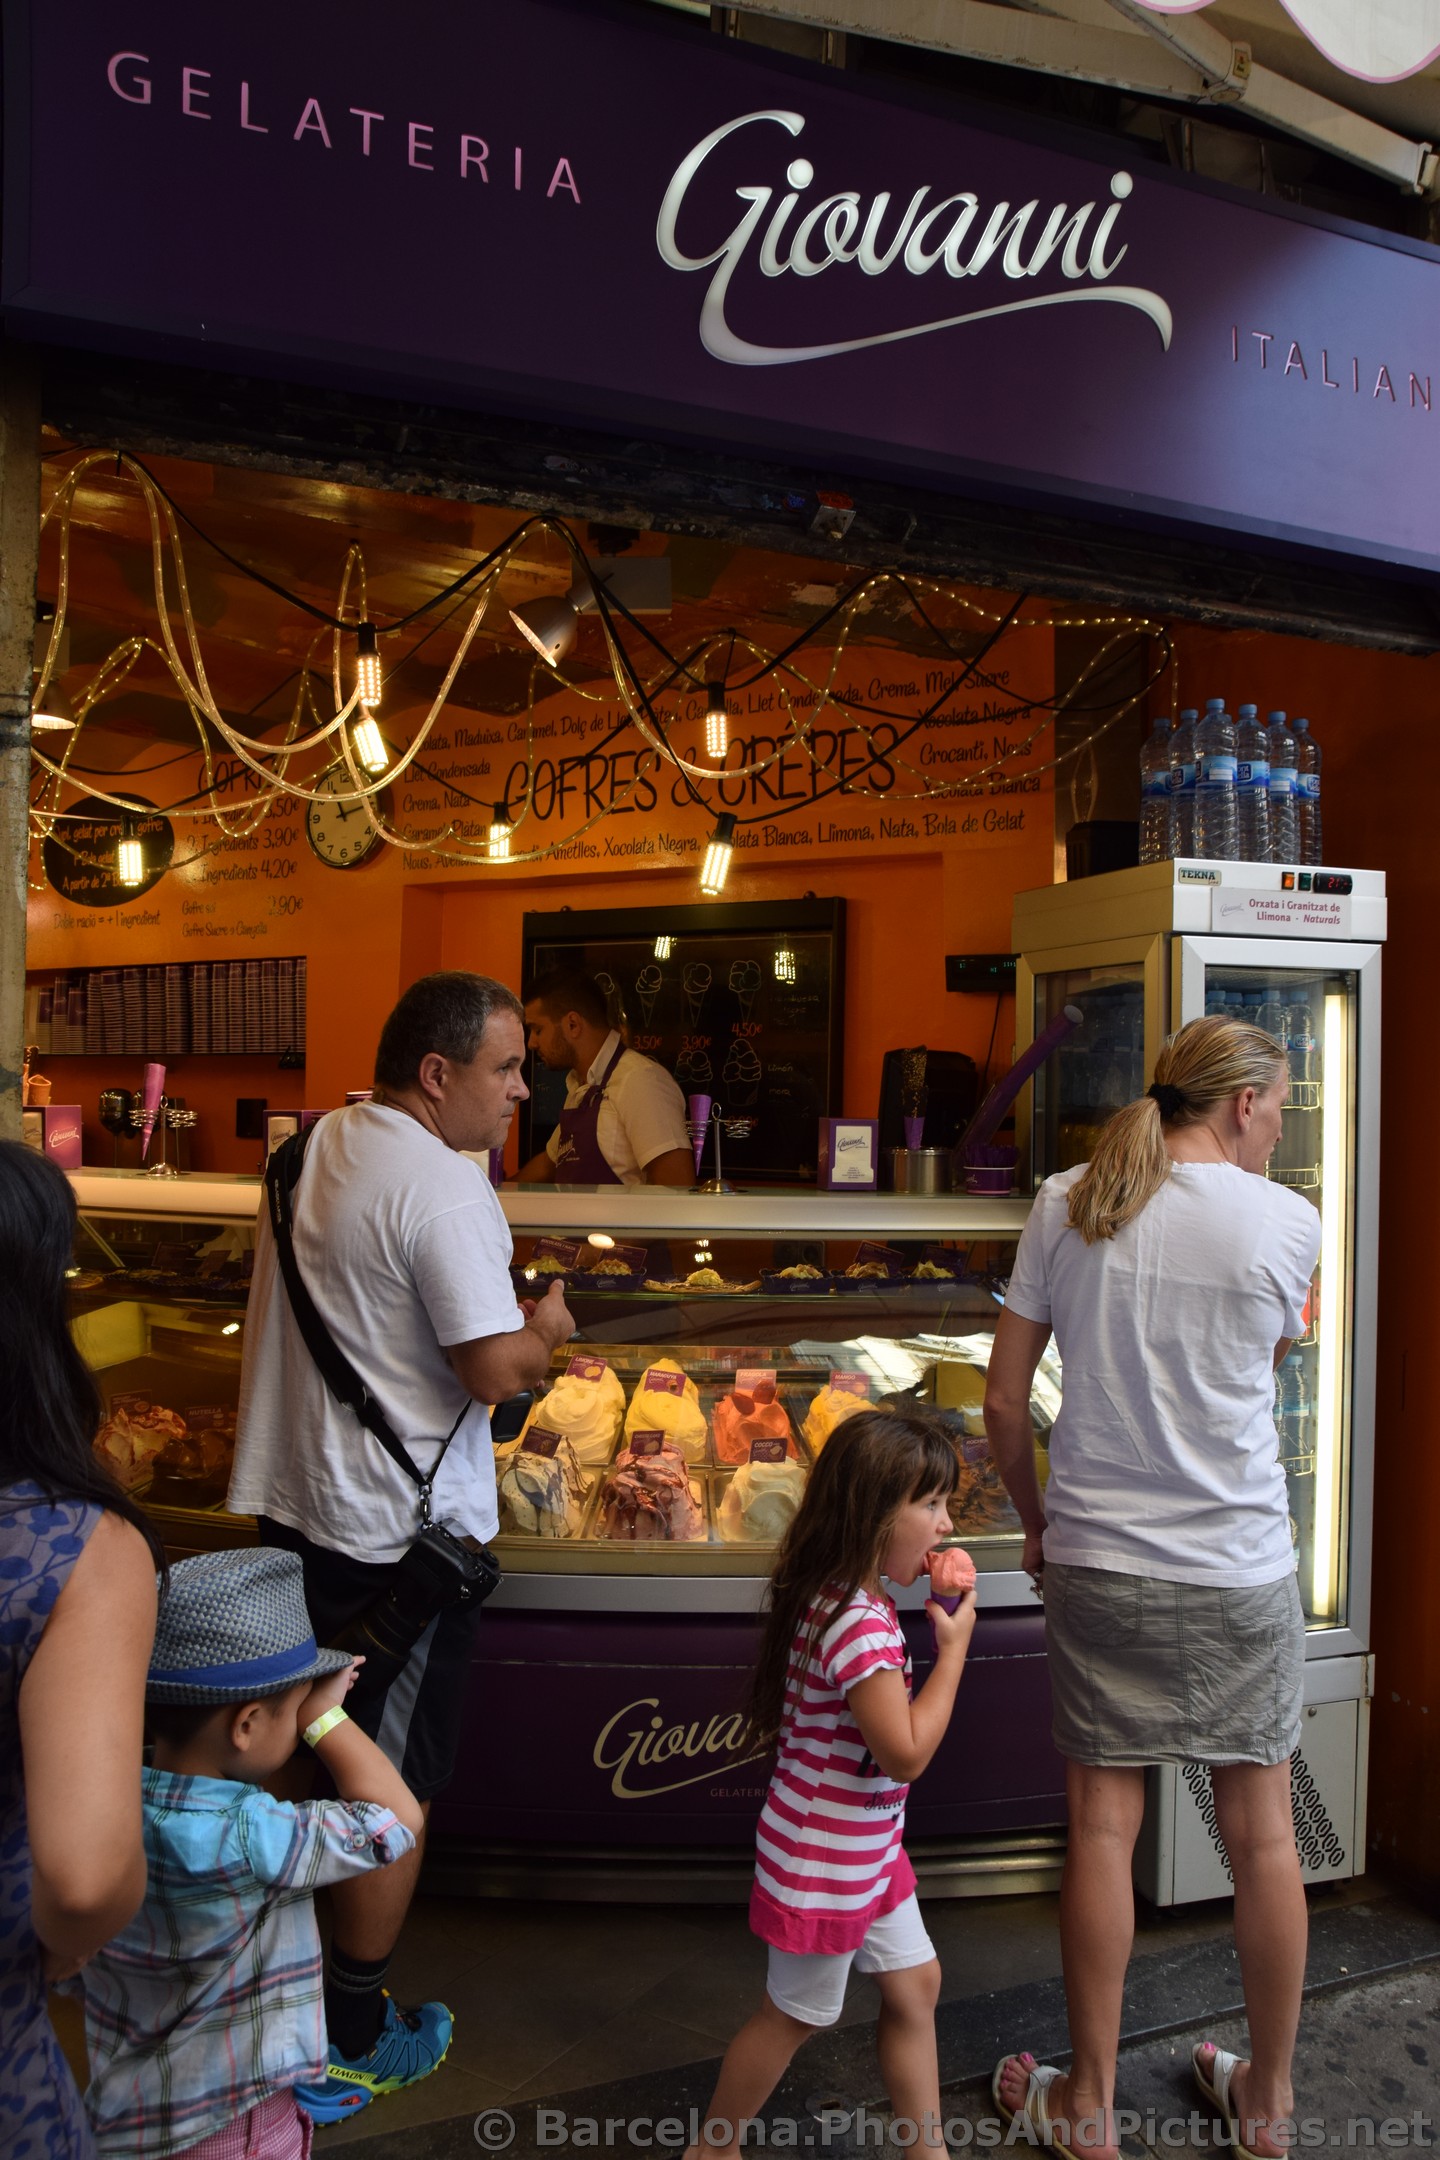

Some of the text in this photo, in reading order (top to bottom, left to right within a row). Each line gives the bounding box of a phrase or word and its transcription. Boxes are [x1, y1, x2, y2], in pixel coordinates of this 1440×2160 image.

[107, 50, 582, 204] GELATERIA
[656, 109, 1173, 366] Giovanni
[1232, 325, 1431, 411] ITALIAN
[507, 721, 557, 742] Carmel,
[590, 713, 604, 732] de
[748, 693, 774, 713] Llet
[965, 670, 1009, 689] Sucre
[427, 758, 491, 780] Condensada
[327, 781, 333, 791] 11
[444, 788, 470, 809] Nata
[312, 814, 321, 824] 9
[317, 832, 325, 842] 8
[364, 826, 372, 836] 4
[604, 835, 655, 857] Xocolata
[922, 813, 957, 836] Bola
[961, 813, 978, 833] de
[983, 808, 1025, 833] Gelat
[327, 845, 334, 855] 7
[340, 848, 348, 858] 6
[354, 841, 362, 851] 5
[1181, 869, 1216, 881] TEKNA
[1249, 898, 1341, 913] Orxata i Granitzat de
[1256, 911, 1291, 922] Llimona
[1303, 914, 1341, 925] Naturals
[593, 1698, 768, 1799] Giova
